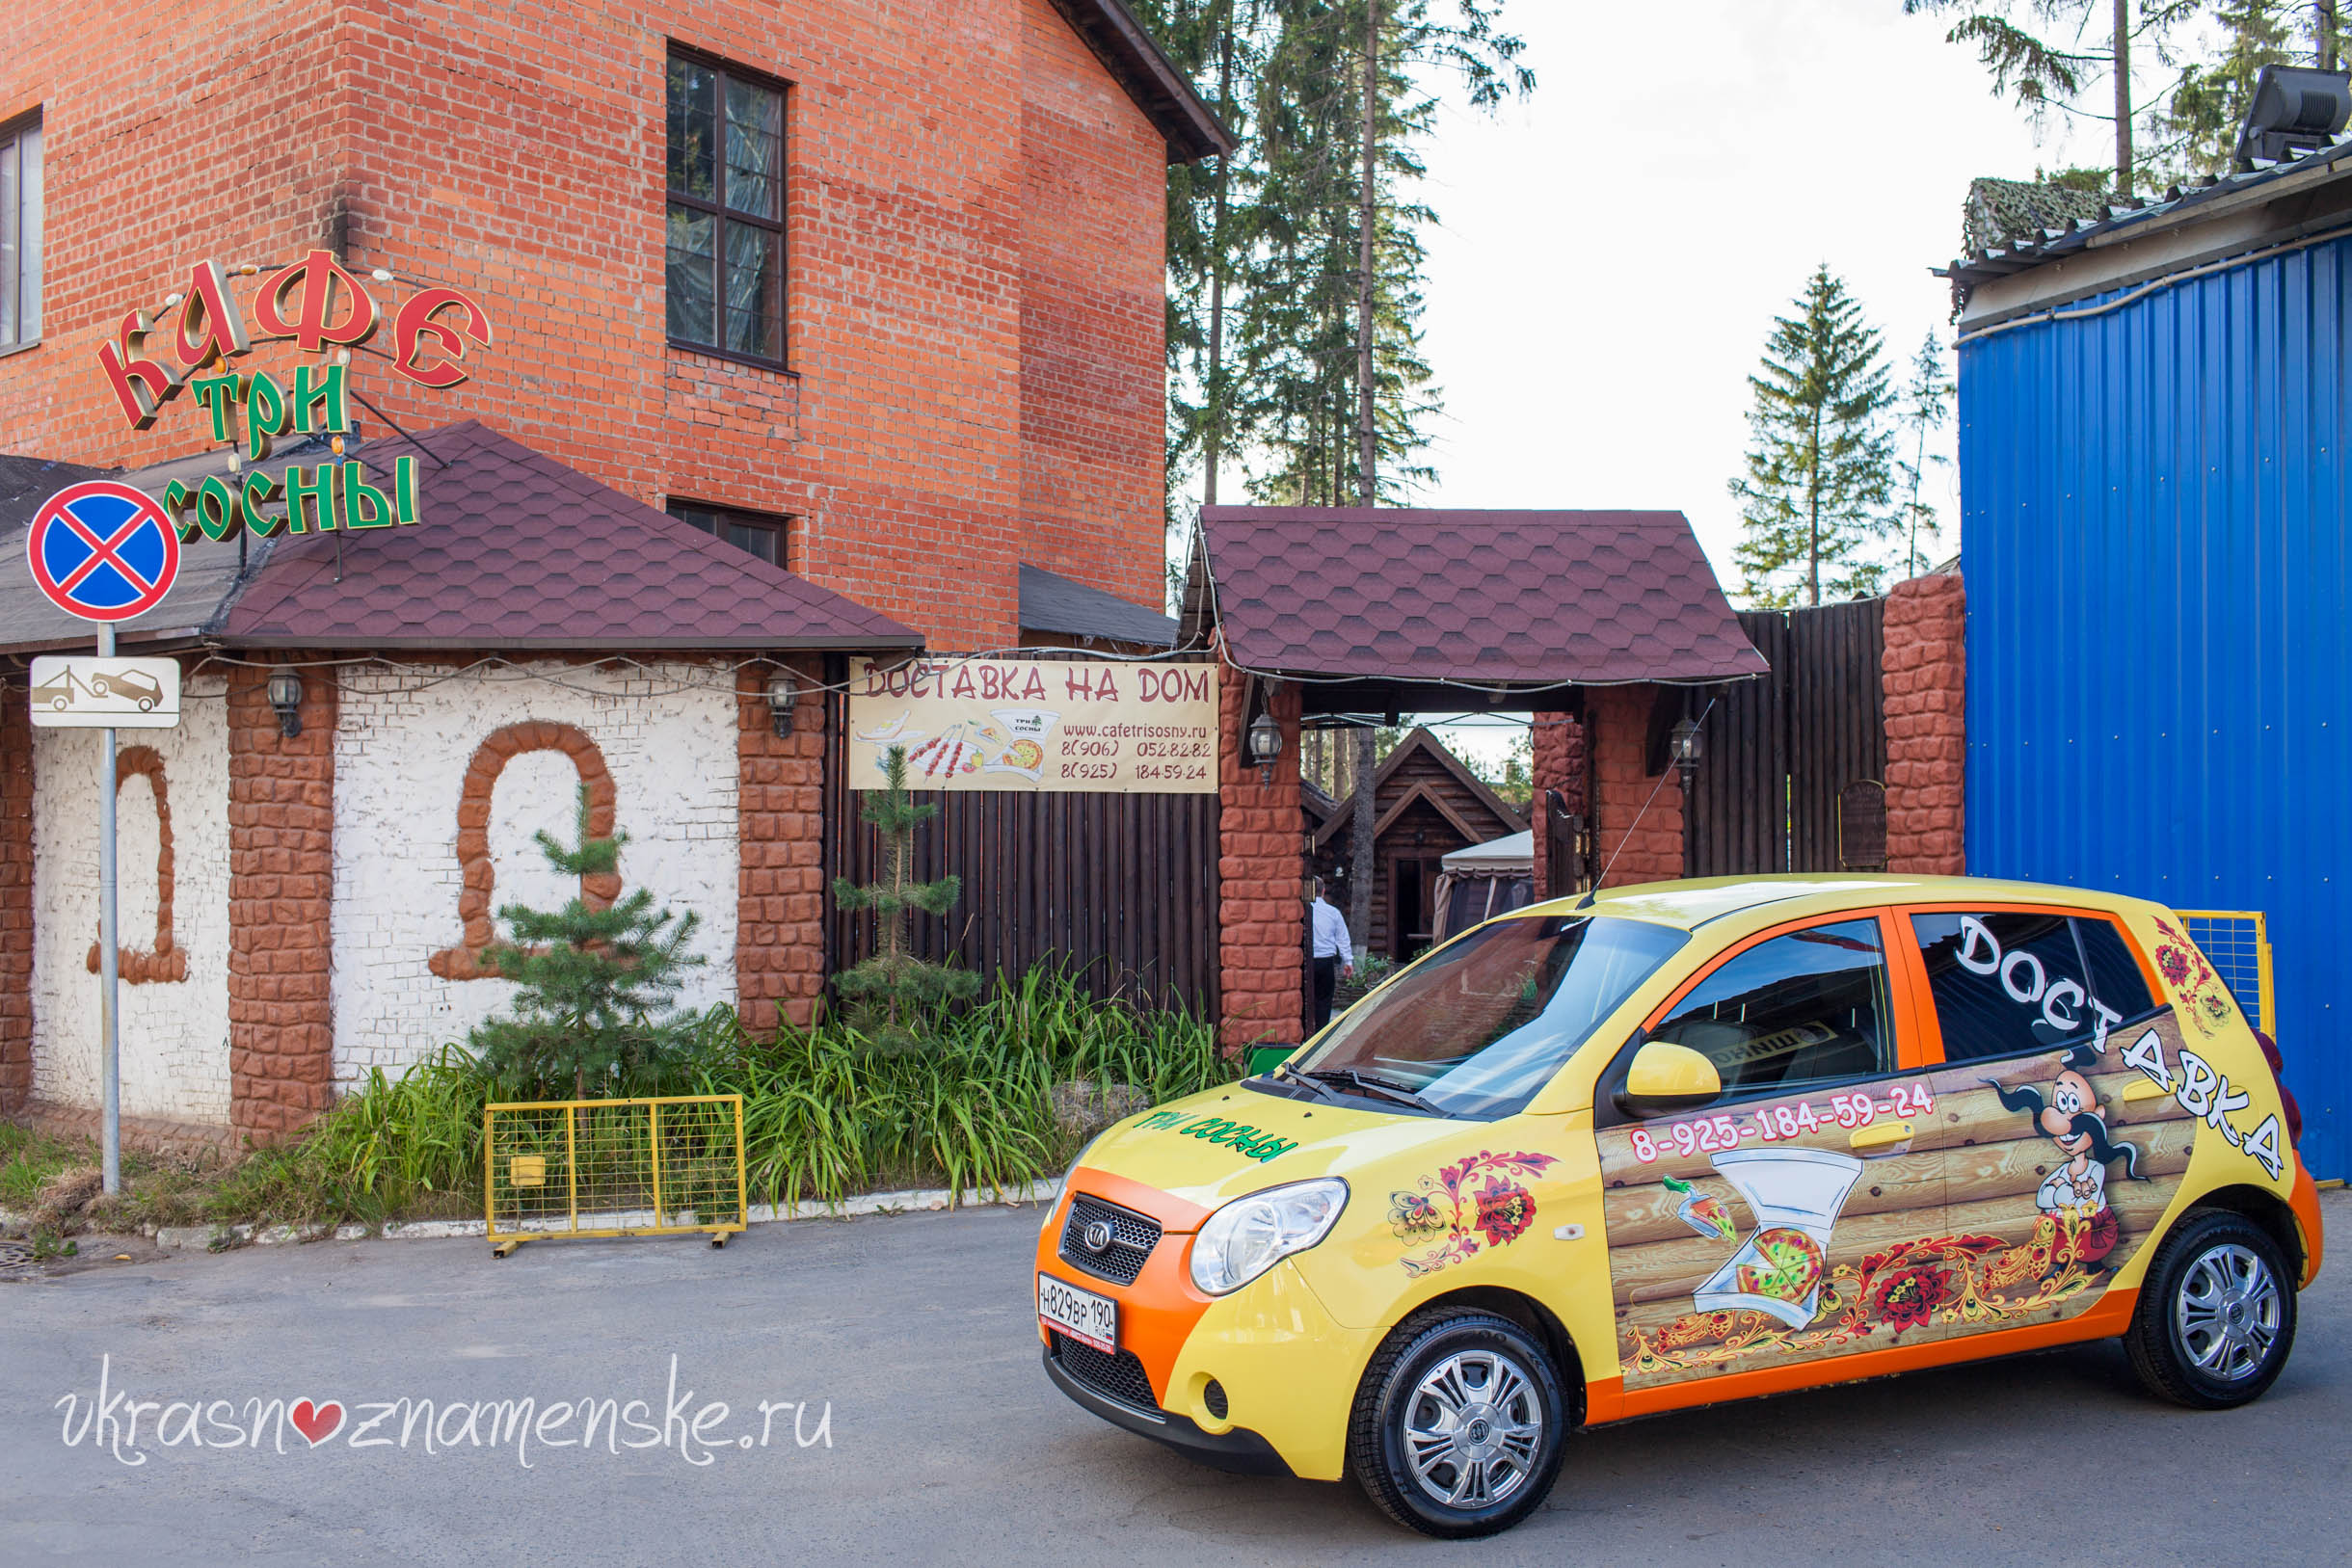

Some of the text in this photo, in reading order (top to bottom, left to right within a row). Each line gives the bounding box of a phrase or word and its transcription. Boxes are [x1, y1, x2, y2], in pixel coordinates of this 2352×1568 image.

[97, 250, 493, 430] КАФЕ
[192, 364, 351, 461] ТРИ
[162, 456, 420, 544] СОСНЫ
[1065, 667, 1119, 703] НА
[1063, 723, 1207, 738] www.cafetrisosny.ru
[1061, 739, 1119, 757] 8(906)
[1061, 762, 1117, 780] 8(925)
[1630, 1082, 1934, 1164] 8-925-184-59-24
[1089, 1225, 1105, 1245] KIA
[1090, 1299, 1110, 1328] 190
